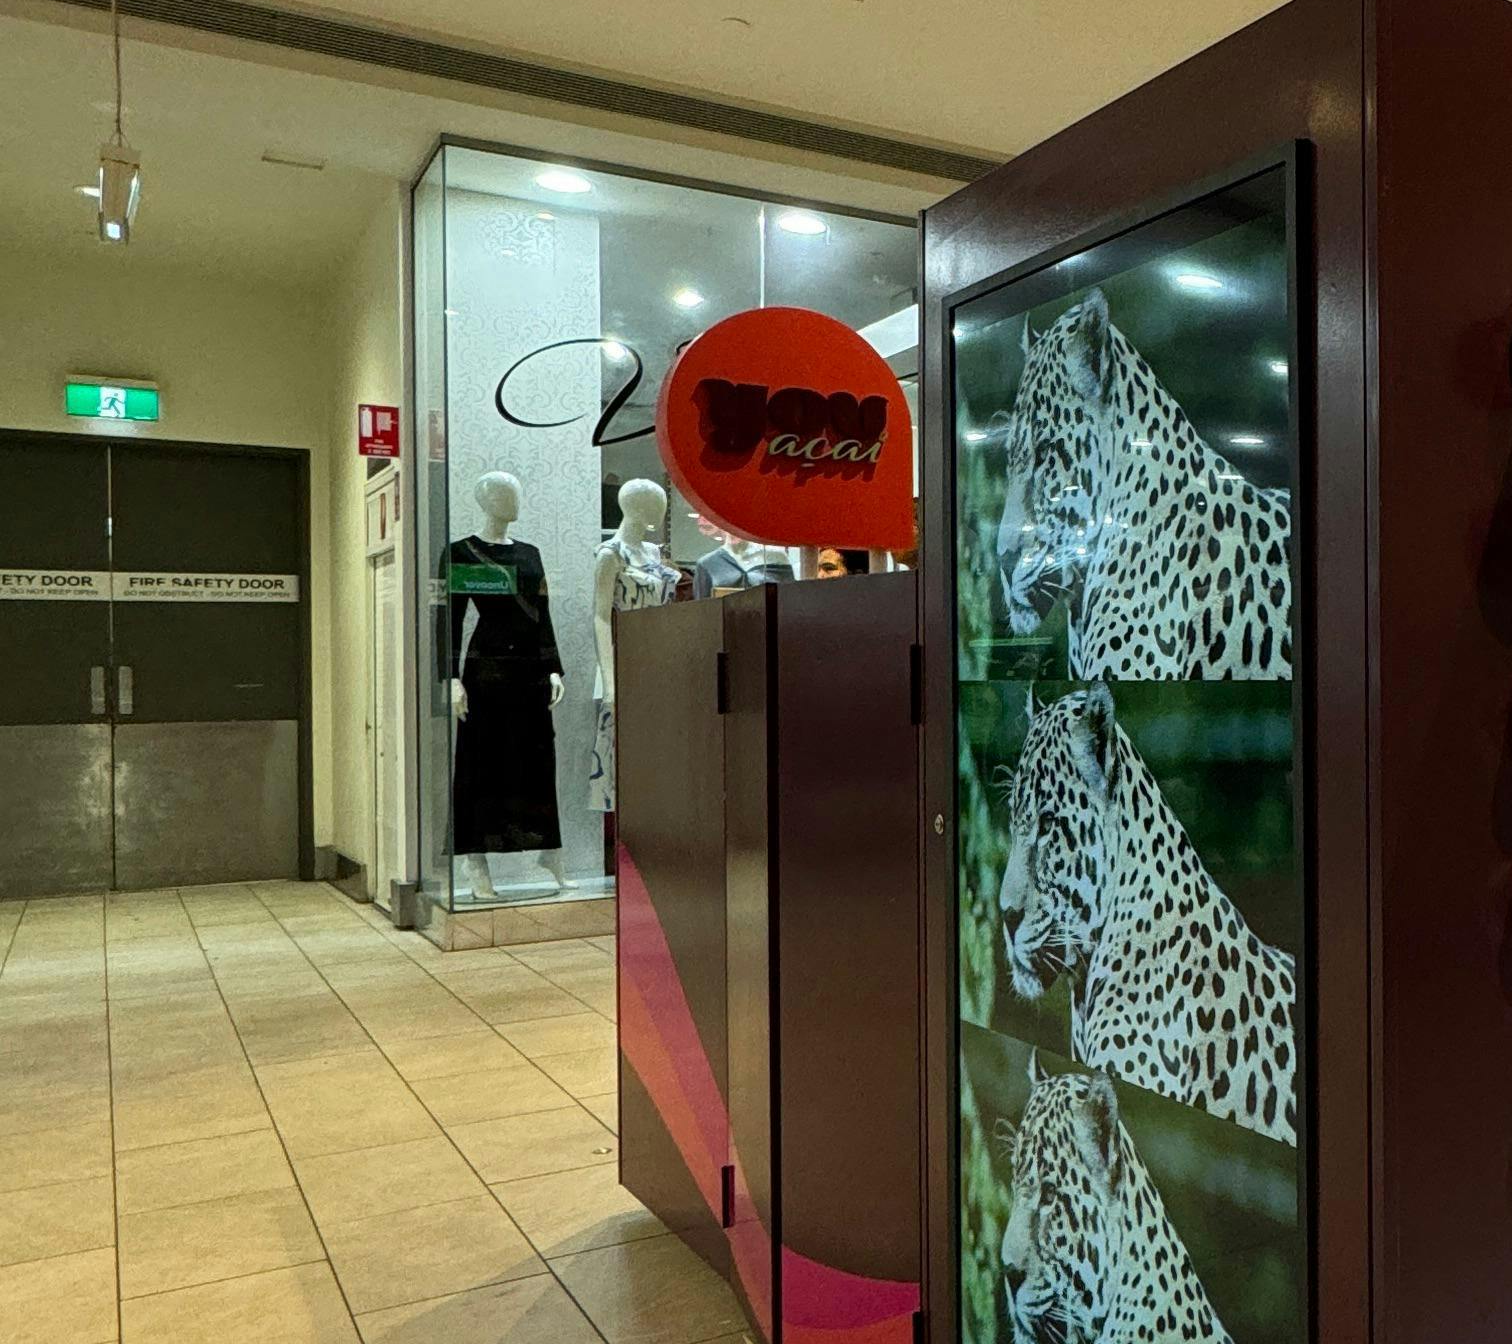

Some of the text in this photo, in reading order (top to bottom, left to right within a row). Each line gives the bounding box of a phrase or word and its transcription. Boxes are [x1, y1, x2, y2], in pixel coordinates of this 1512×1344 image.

[41, 575, 93, 587] DOOR
[129, 577, 285, 589] FIRE SAFETY DOOR
